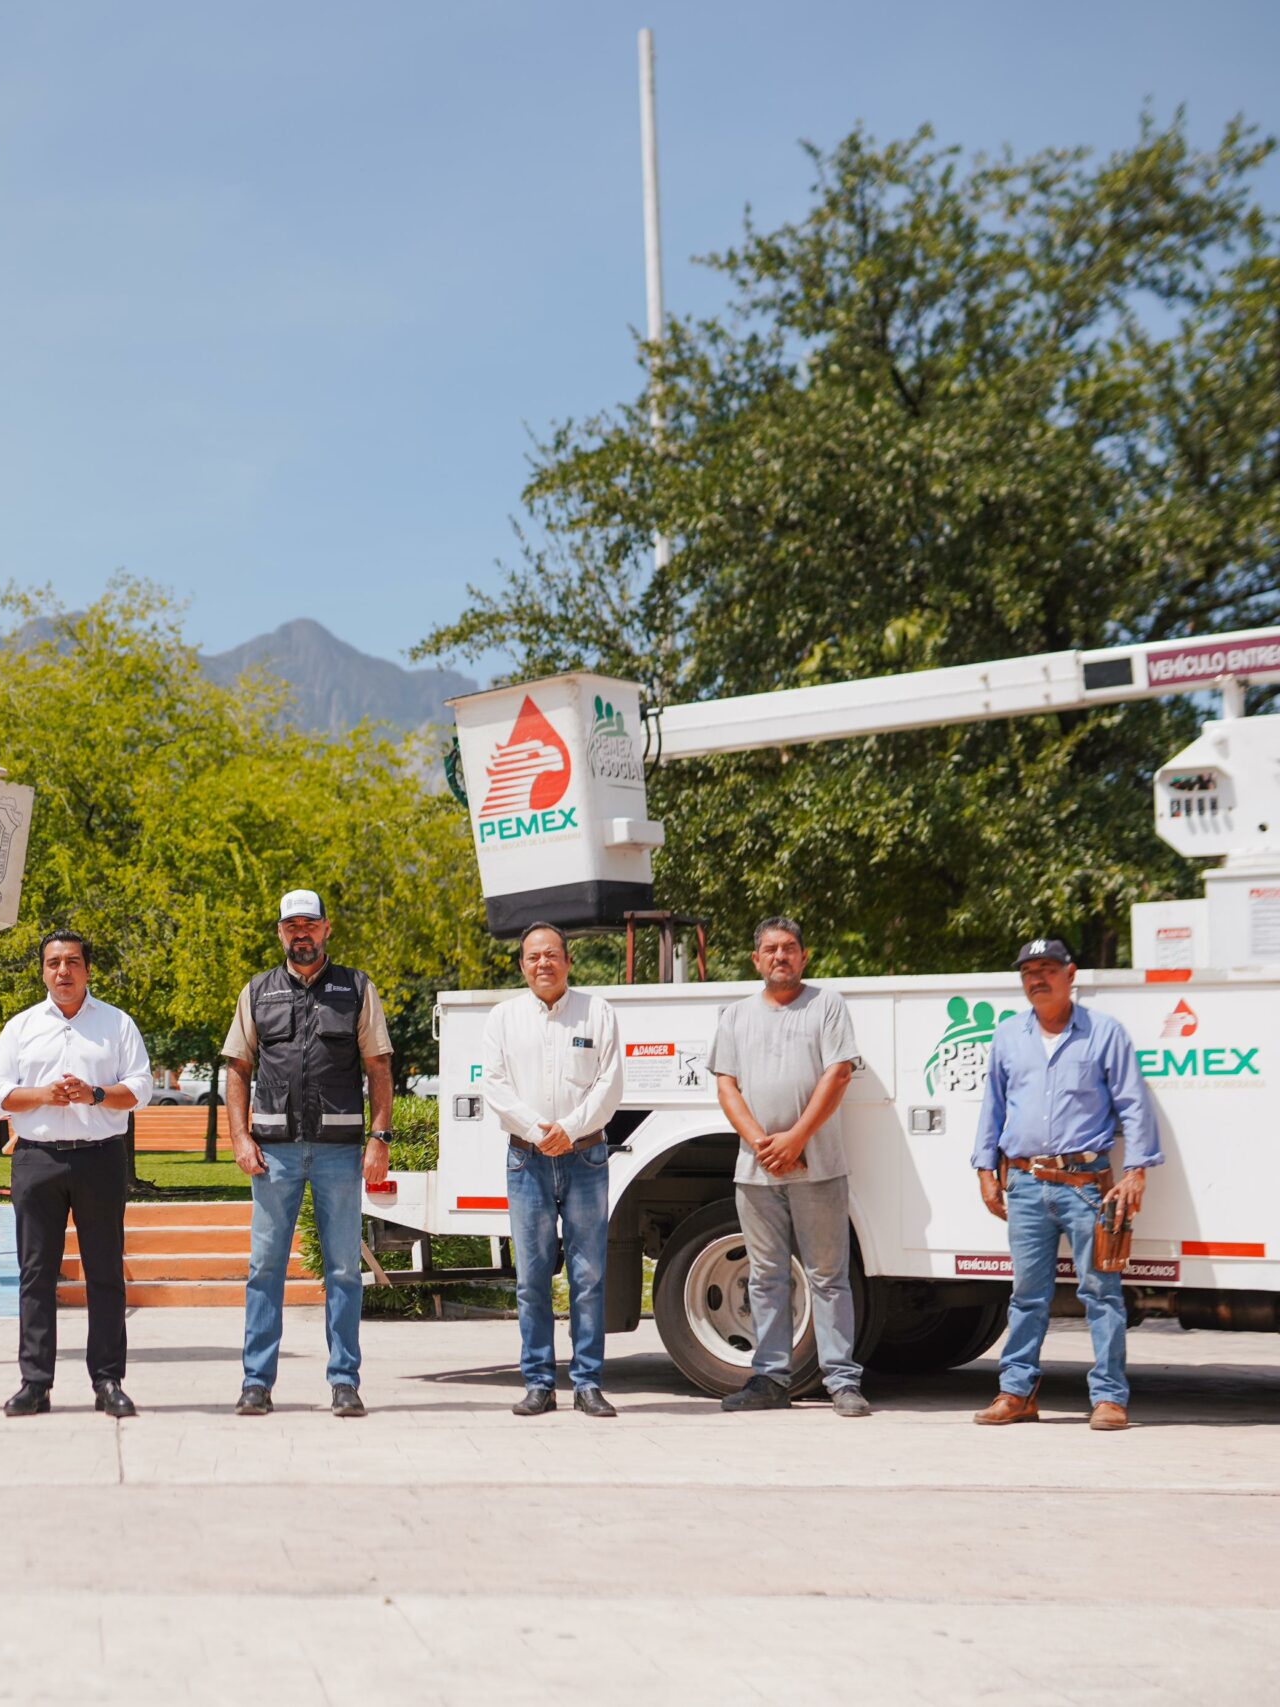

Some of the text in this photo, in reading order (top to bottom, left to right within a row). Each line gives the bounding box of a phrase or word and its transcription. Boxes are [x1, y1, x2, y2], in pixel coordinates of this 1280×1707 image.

[1148, 653, 1225, 681] VEHÍCULO
[479, 806, 578, 843] PEMEX
[640, 1045, 669, 1056] DANGER
[940, 1040, 989, 1066] PEM
[1135, 1048, 1260, 1076] EMEX
[957, 1258, 999, 1271] VEHÍCULO
[1121, 1264, 1176, 1276] MEXICANOS
